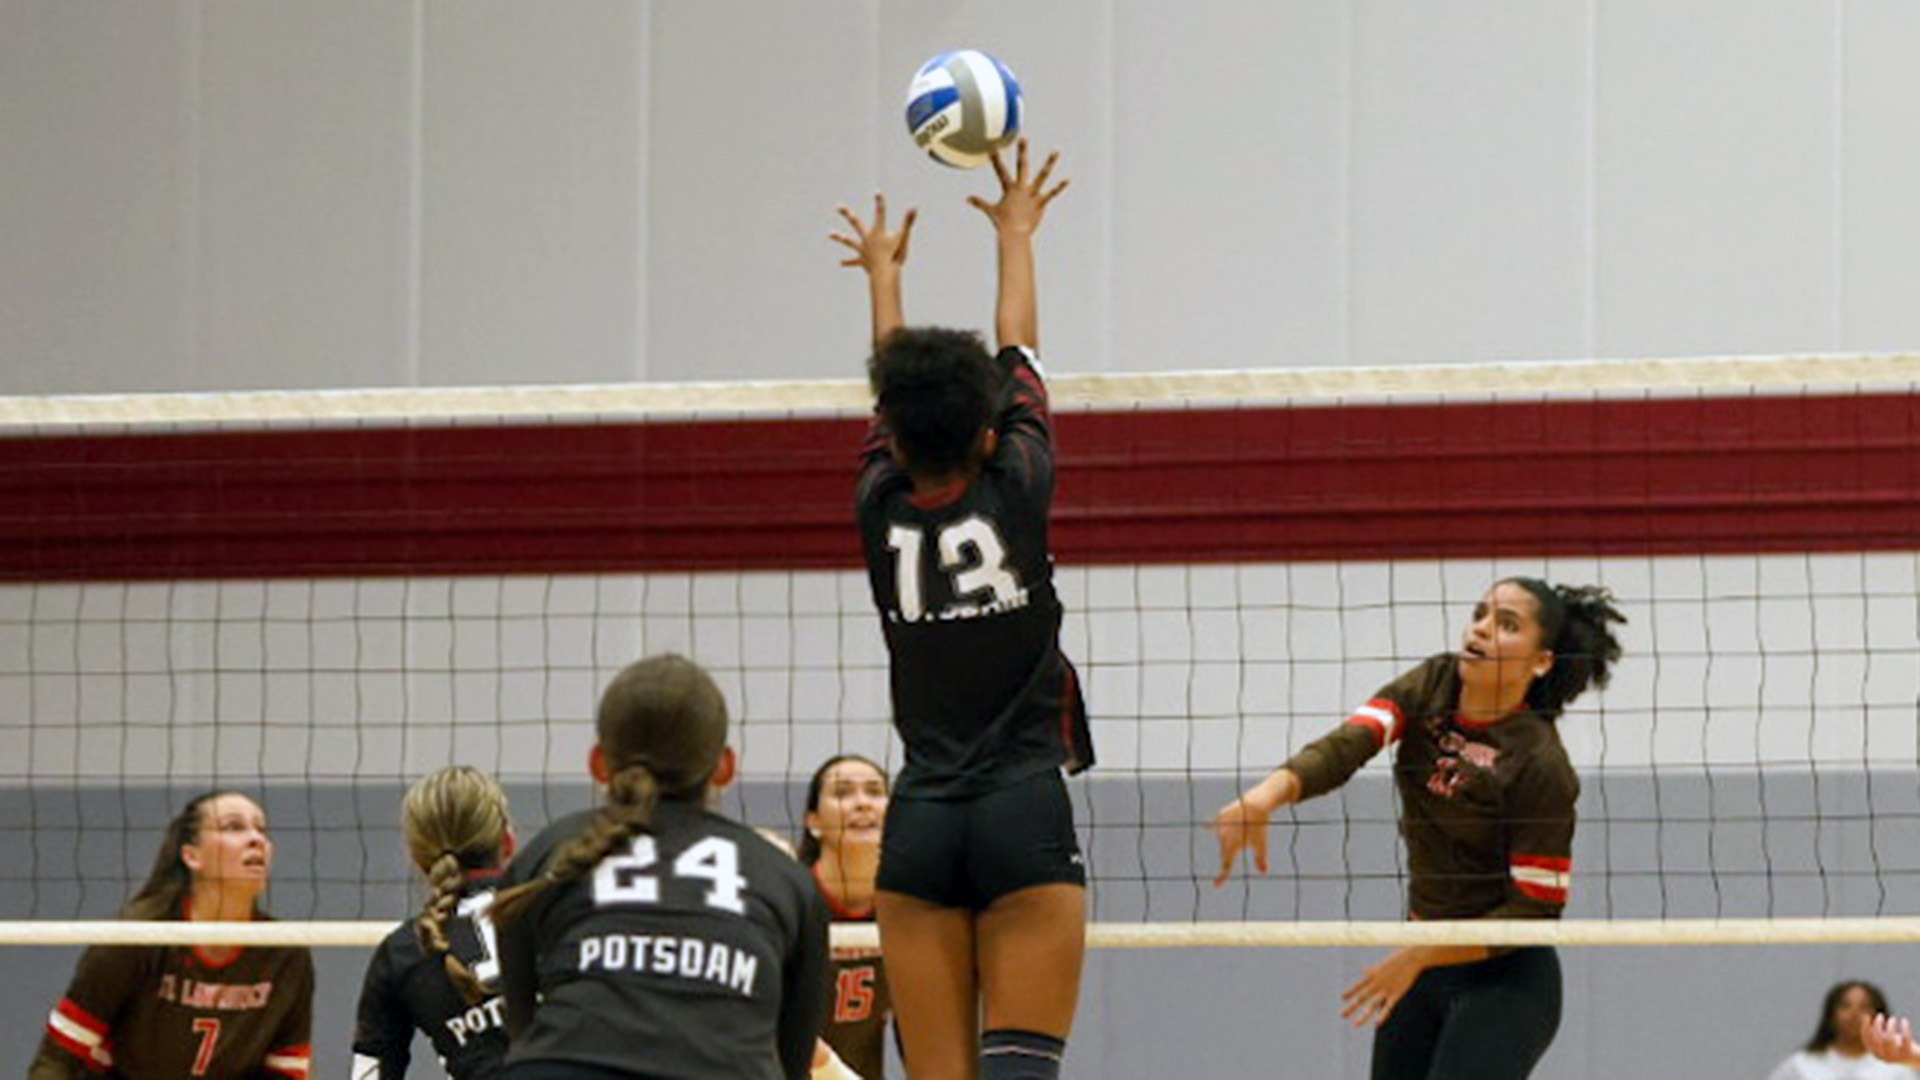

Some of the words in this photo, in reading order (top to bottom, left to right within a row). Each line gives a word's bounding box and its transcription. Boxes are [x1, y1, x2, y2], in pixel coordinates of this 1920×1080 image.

[887, 516, 1019, 623] 13
[593, 834, 747, 916] 24
[579, 934, 756, 997] POTSDAM
[834, 966, 875, 1022] 15
[191, 1018, 219, 1076] 7
[446, 996, 505, 1047] POT
